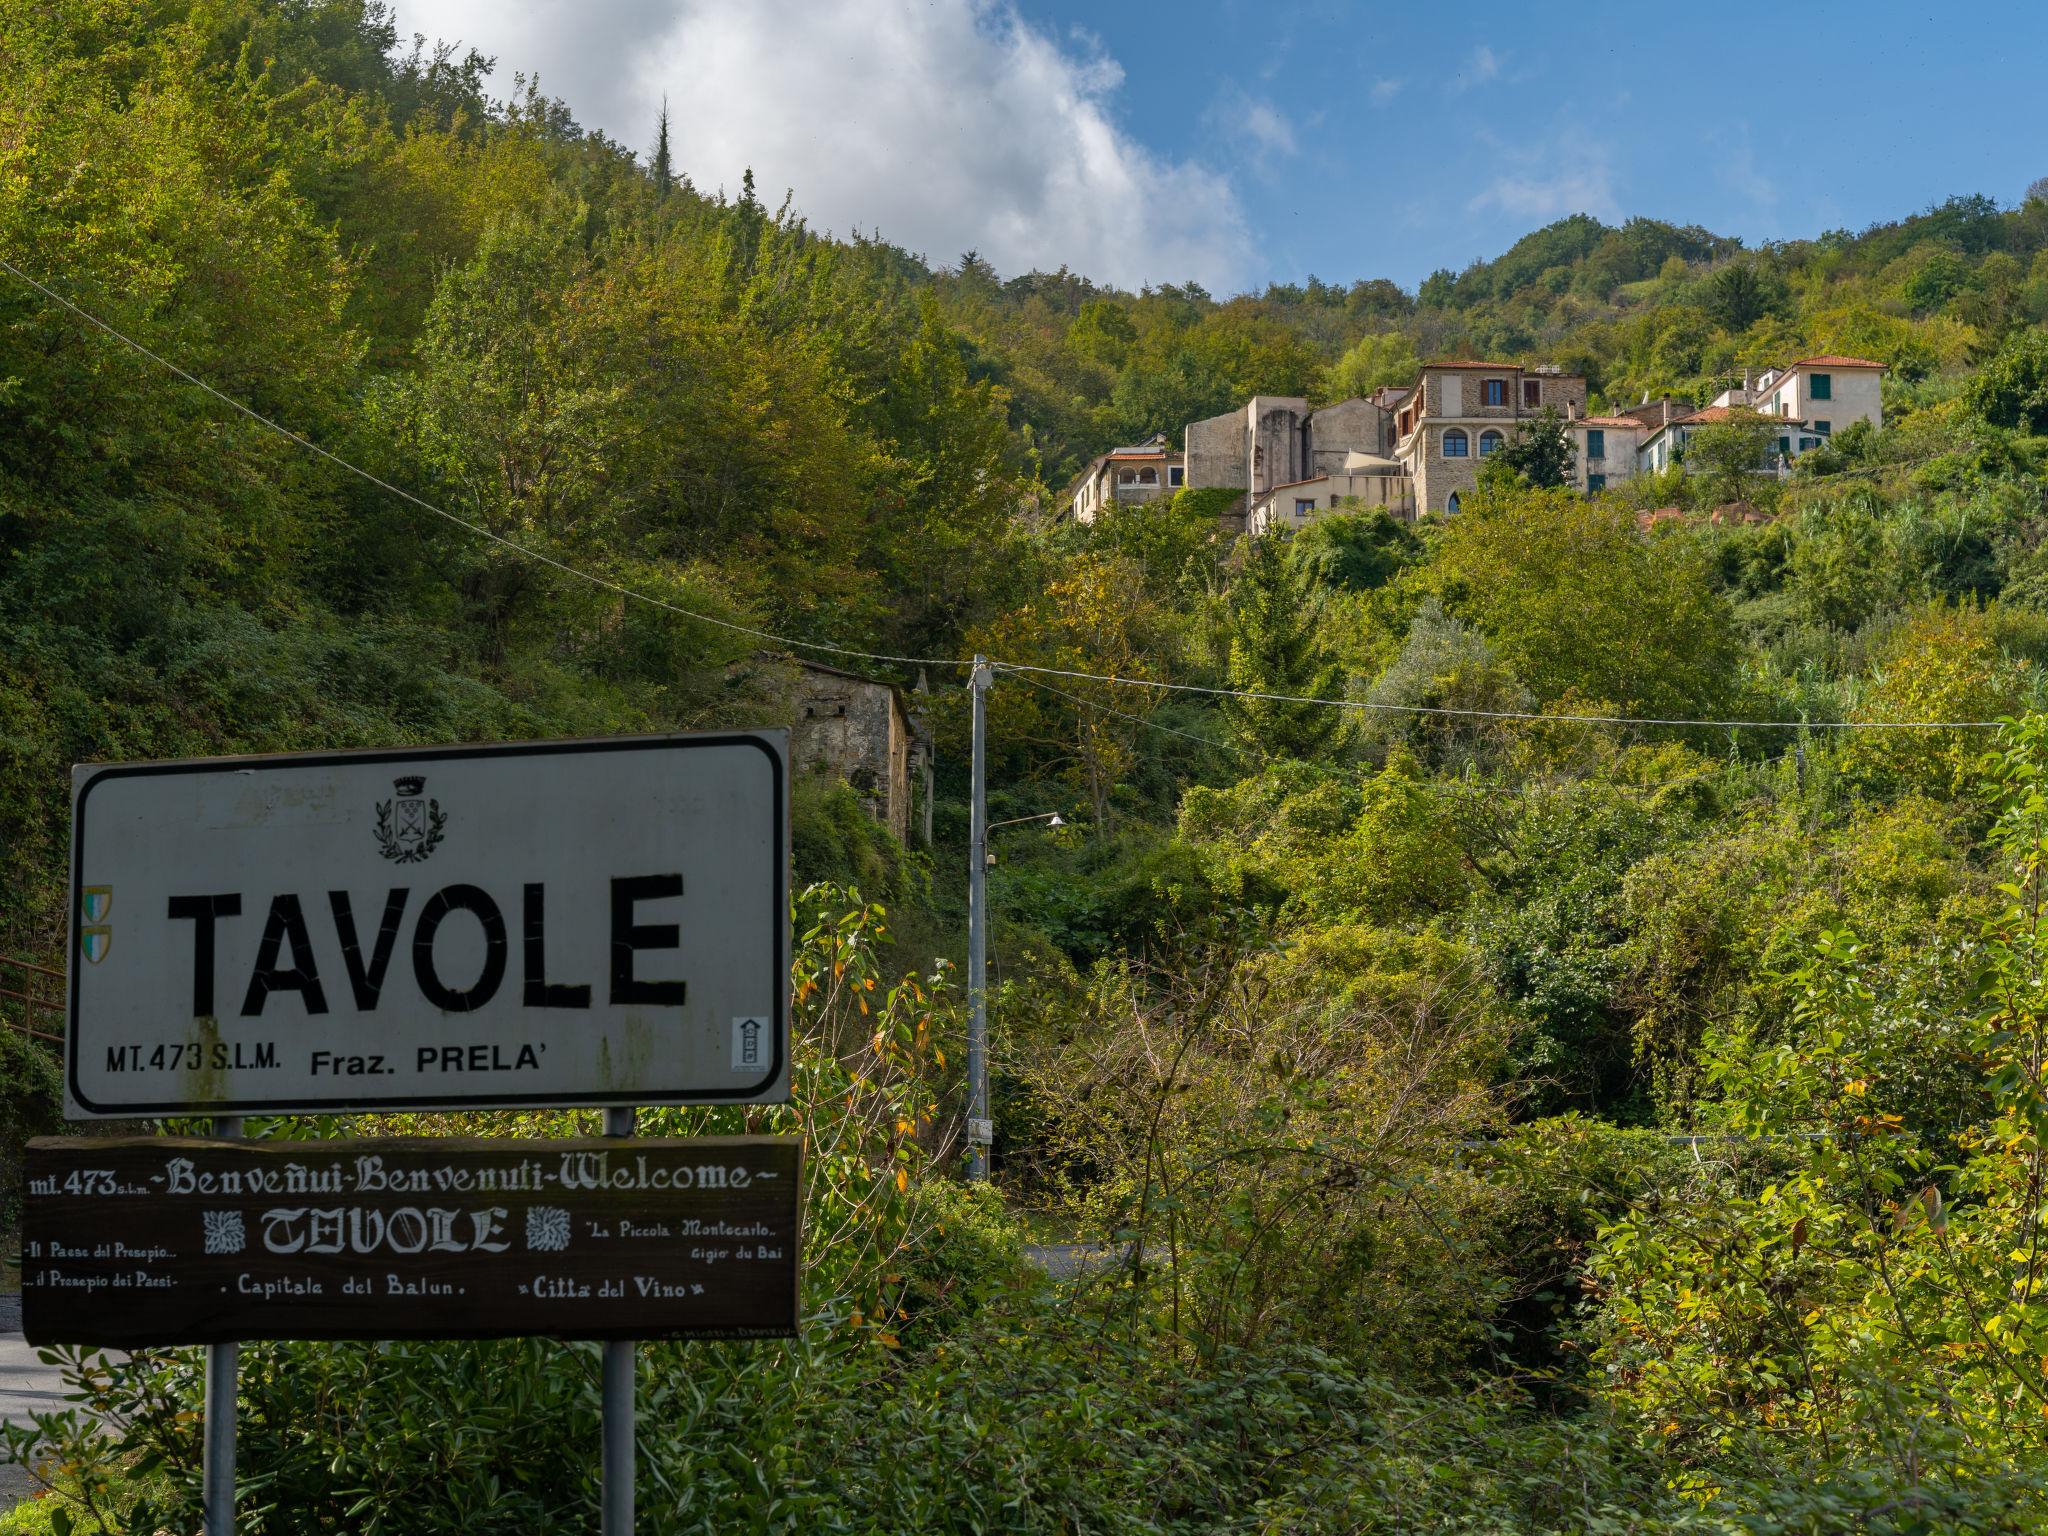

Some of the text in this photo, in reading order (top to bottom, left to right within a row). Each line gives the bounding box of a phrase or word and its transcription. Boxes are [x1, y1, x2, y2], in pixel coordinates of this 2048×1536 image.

[168, 873, 687, 1017] TAVOLE
[212, 1042, 281, 1071] S.L.M.
[311, 1050, 394, 1076] Fraz.
[417, 1043, 546, 1073] PRELA'
[260, 1206, 511, 1254] TAVOLE
[619, 1220, 671, 1238] Piccola
[50, 1241, 89, 1258] Paese
[93, 1243, 111, 1258] del
[735, 1245, 753, 1260] du
[757, 1245, 782, 1260] Bai
[49, 1269, 109, 1294] Presepio
[112, 1272, 132, 1287] dei
[238, 1273, 323, 1300] Capitale
[342, 1276, 372, 1295] del
[597, 1279, 624, 1298] del
[633, 1276, 686, 1298] Vino
